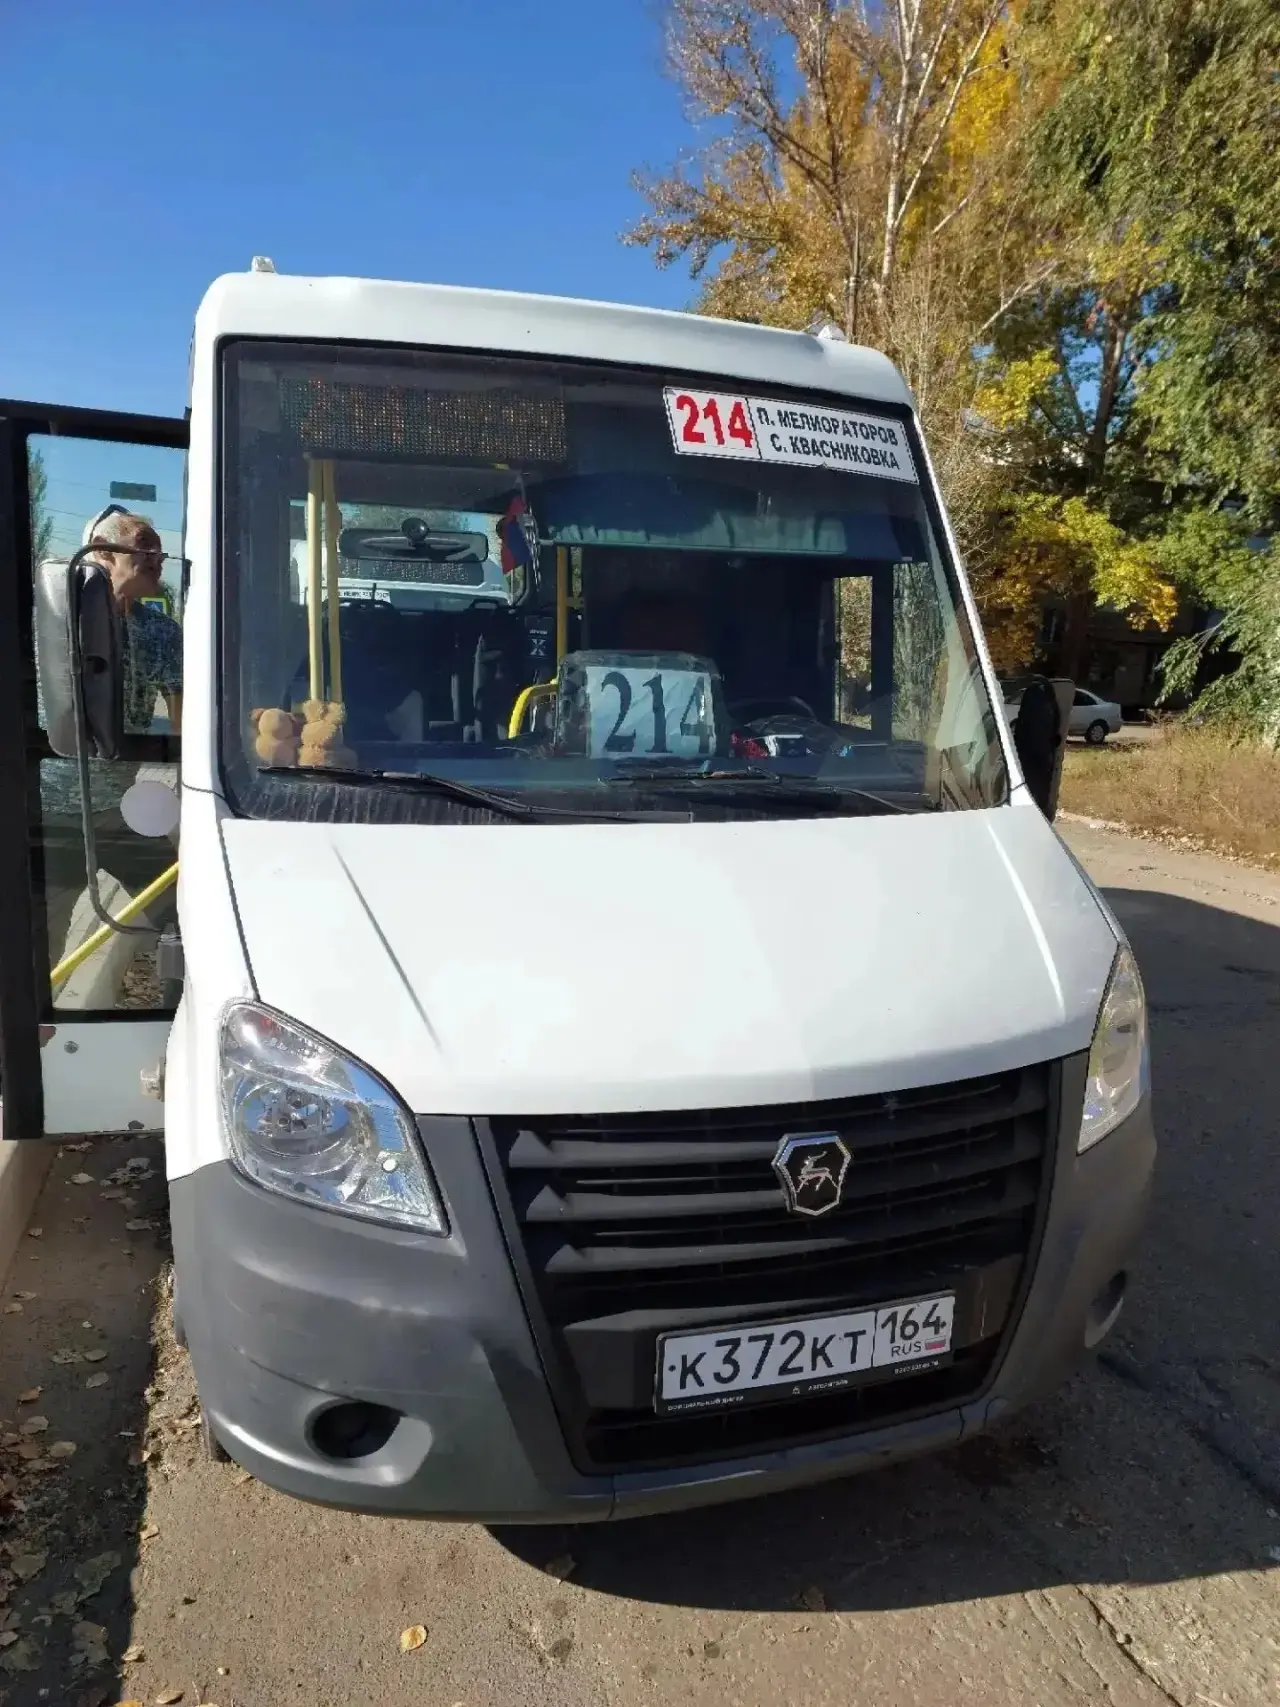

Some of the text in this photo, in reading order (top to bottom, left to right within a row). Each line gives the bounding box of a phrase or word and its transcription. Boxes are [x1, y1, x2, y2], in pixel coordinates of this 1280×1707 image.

[675, 394, 754, 449] 214
[756, 406, 899, 447] П. МЕЛИОРАТОРОВ
[769, 433, 900, 471] С. КВАСНИКОВКА
[600, 671, 712, 754] 214
[880, 1302, 941, 1344] 164
[678, 1328, 867, 1391] К372КТ
[890, 1341, 922, 1359] RUS
